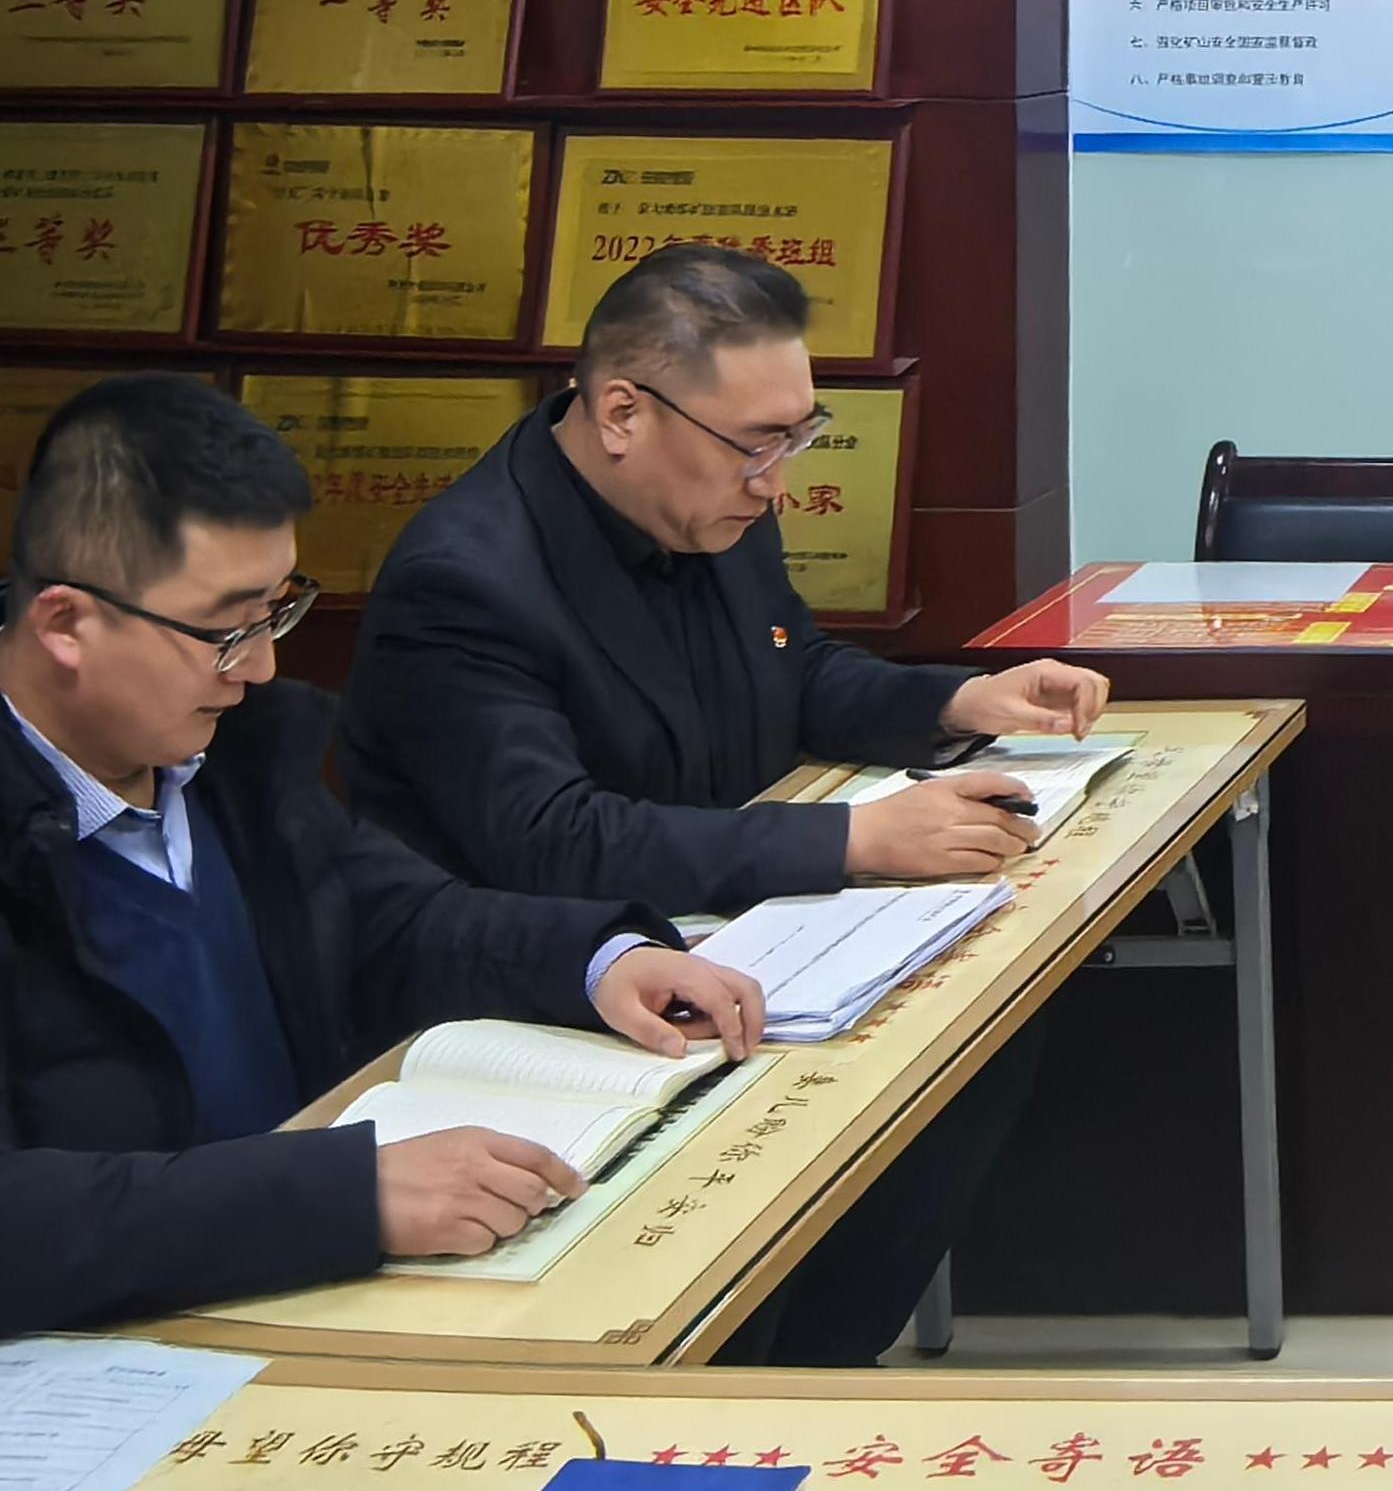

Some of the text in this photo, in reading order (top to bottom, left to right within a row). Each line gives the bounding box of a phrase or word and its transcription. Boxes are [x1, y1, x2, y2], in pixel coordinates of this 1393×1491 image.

[294, 220, 451, 257] 优秀奖
[824, 1432, 1206, 1484] 安全寄语
